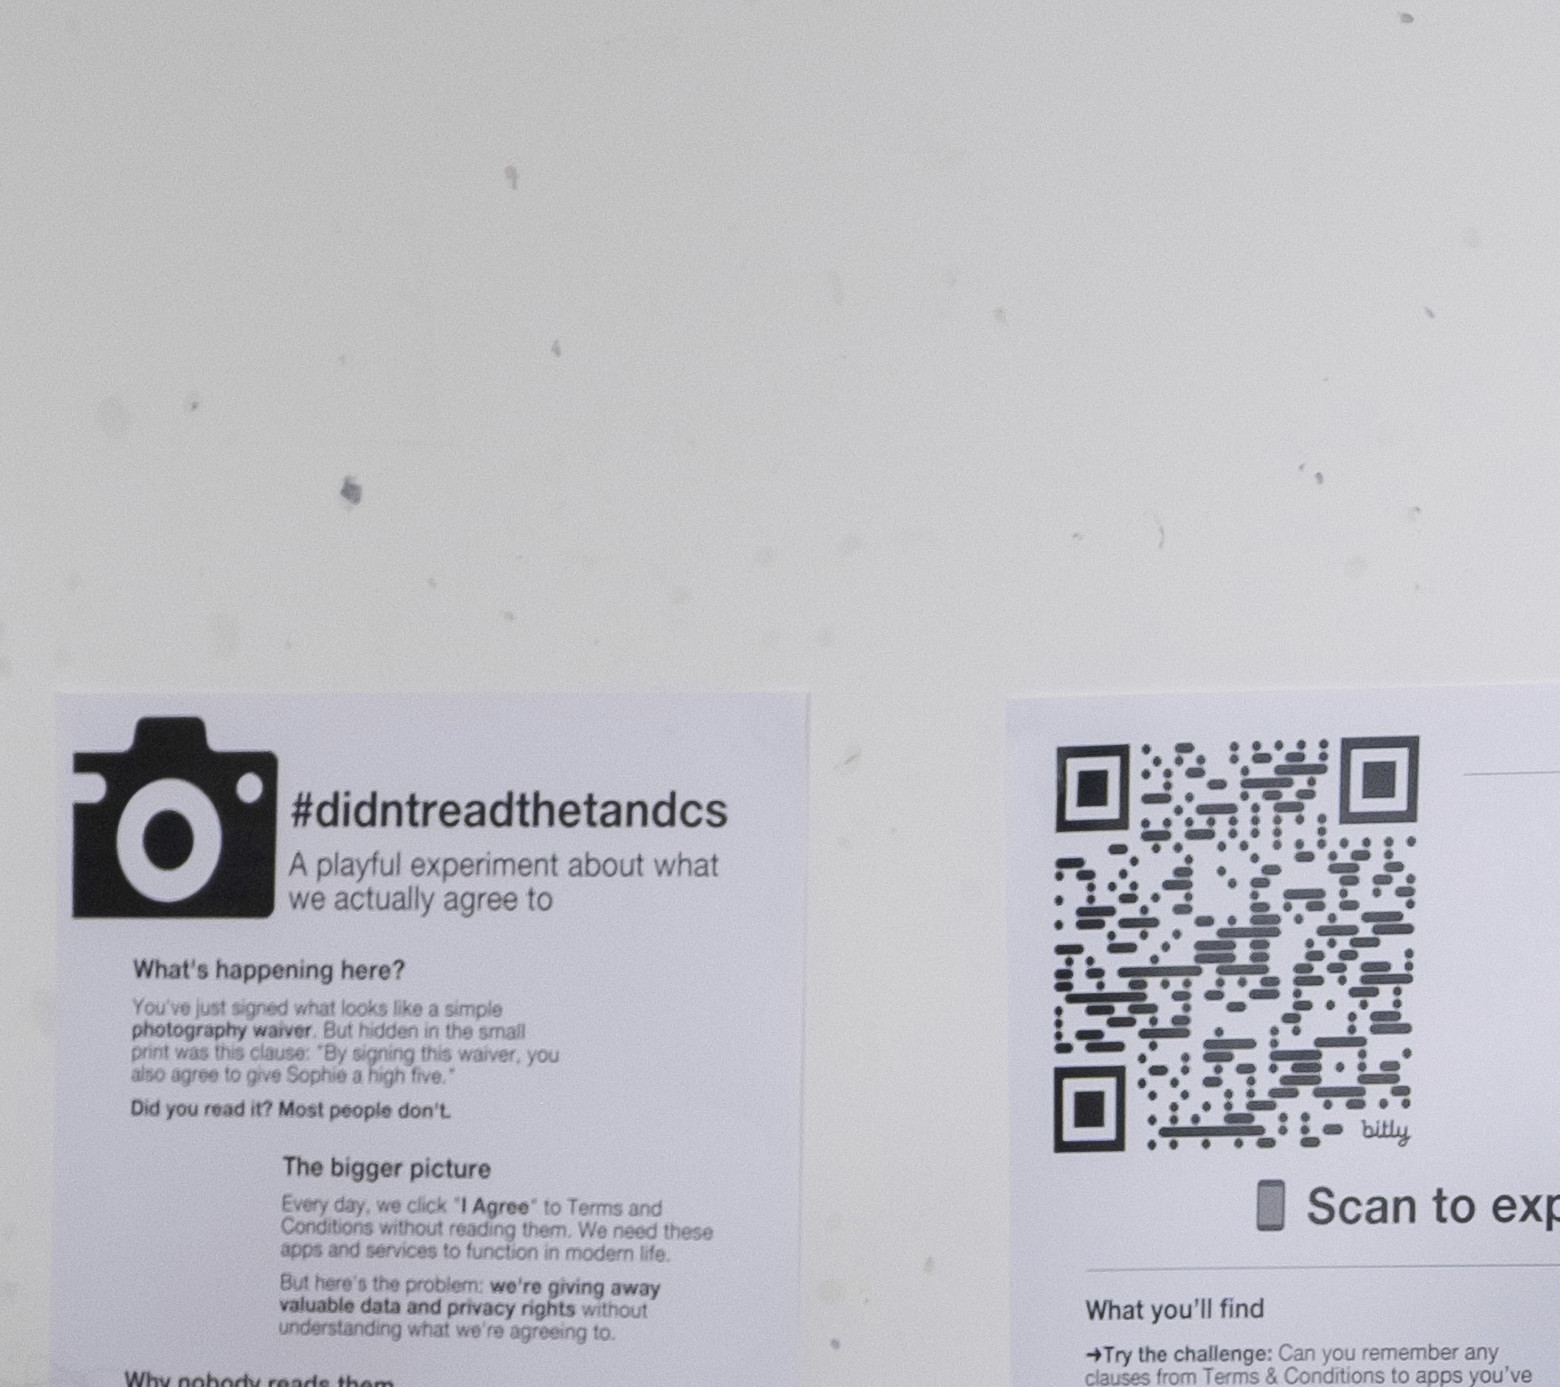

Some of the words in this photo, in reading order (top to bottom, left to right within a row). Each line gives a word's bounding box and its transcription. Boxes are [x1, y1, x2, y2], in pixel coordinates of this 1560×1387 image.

[292, 790, 728, 828] #didntreadthetandcs
[288, 850, 307, 876] A
[316, 850, 401, 883] playful
[410, 851, 558, 883] experiment
[568, 851, 644, 877] about
[654, 852, 718, 877] what
[288, 891, 326, 911] we
[334, 882, 435, 918] actually
[443, 891, 518, 918] agree
[527, 887, 553, 911] to
[133, 959, 209, 980] What's
[216, 959, 333, 985] happening
[341, 959, 405, 980] here?
[131, 1098, 161, 1117] Did
[166, 1103, 199, 1120] you
[204, 1100, 246, 1117] read
[251, 1100, 273, 1117] it?
[279, 1100, 324, 1119] Most
[330, 1102, 392, 1123] people
[1362, 1120, 1411, 1146] bitly
[283, 1156, 324, 1177] The
[331, 1157, 403, 1183] bigger
[410, 1158, 491, 1183] picture
[1308, 1186, 1415, 1225] Scan
[1432, 1188, 1475, 1223] to
[280, 1296, 356, 1313] valuable
[360, 1297, 402, 1315] data
[406, 1298, 442, 1315] and
[448, 1300, 516, 1320] privacy
[522, 1298, 576, 1320] rights
[582, 1299, 646, 1318] without
[1086, 1299, 1144, 1321] What
[1151, 1298, 1212, 1325] you'll
[1220, 1297, 1264, 1318] find
[1103, 1345, 1132, 1367] Try
[1138, 1346, 1167, 1363] the
[1173, 1345, 1272, 1366] challenge:
[1279, 1343, 1315, 1361] Can
[1323, 1348, 1355, 1366] you
[1362, 1343, 1459, 1361] remember
[1465, 1347, 1499, 1365] any
